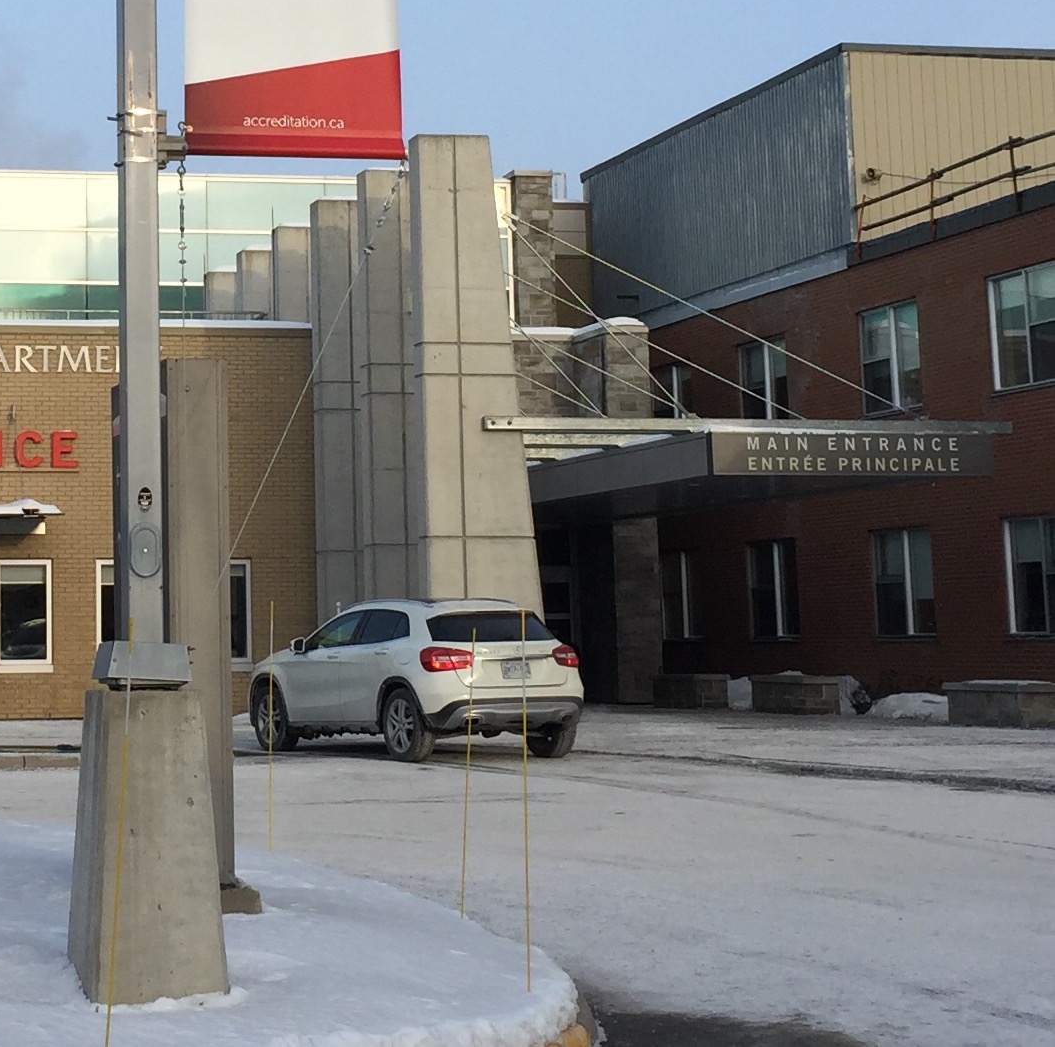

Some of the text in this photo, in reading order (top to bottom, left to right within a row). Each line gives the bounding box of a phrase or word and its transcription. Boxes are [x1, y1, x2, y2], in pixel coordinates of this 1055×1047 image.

[243, 115, 345, 129] accreditation.ca
[747, 436, 959, 452] MAIN ENTRANCE
[748, 454, 960, 472] ENTRÉE PRINCIPALE
